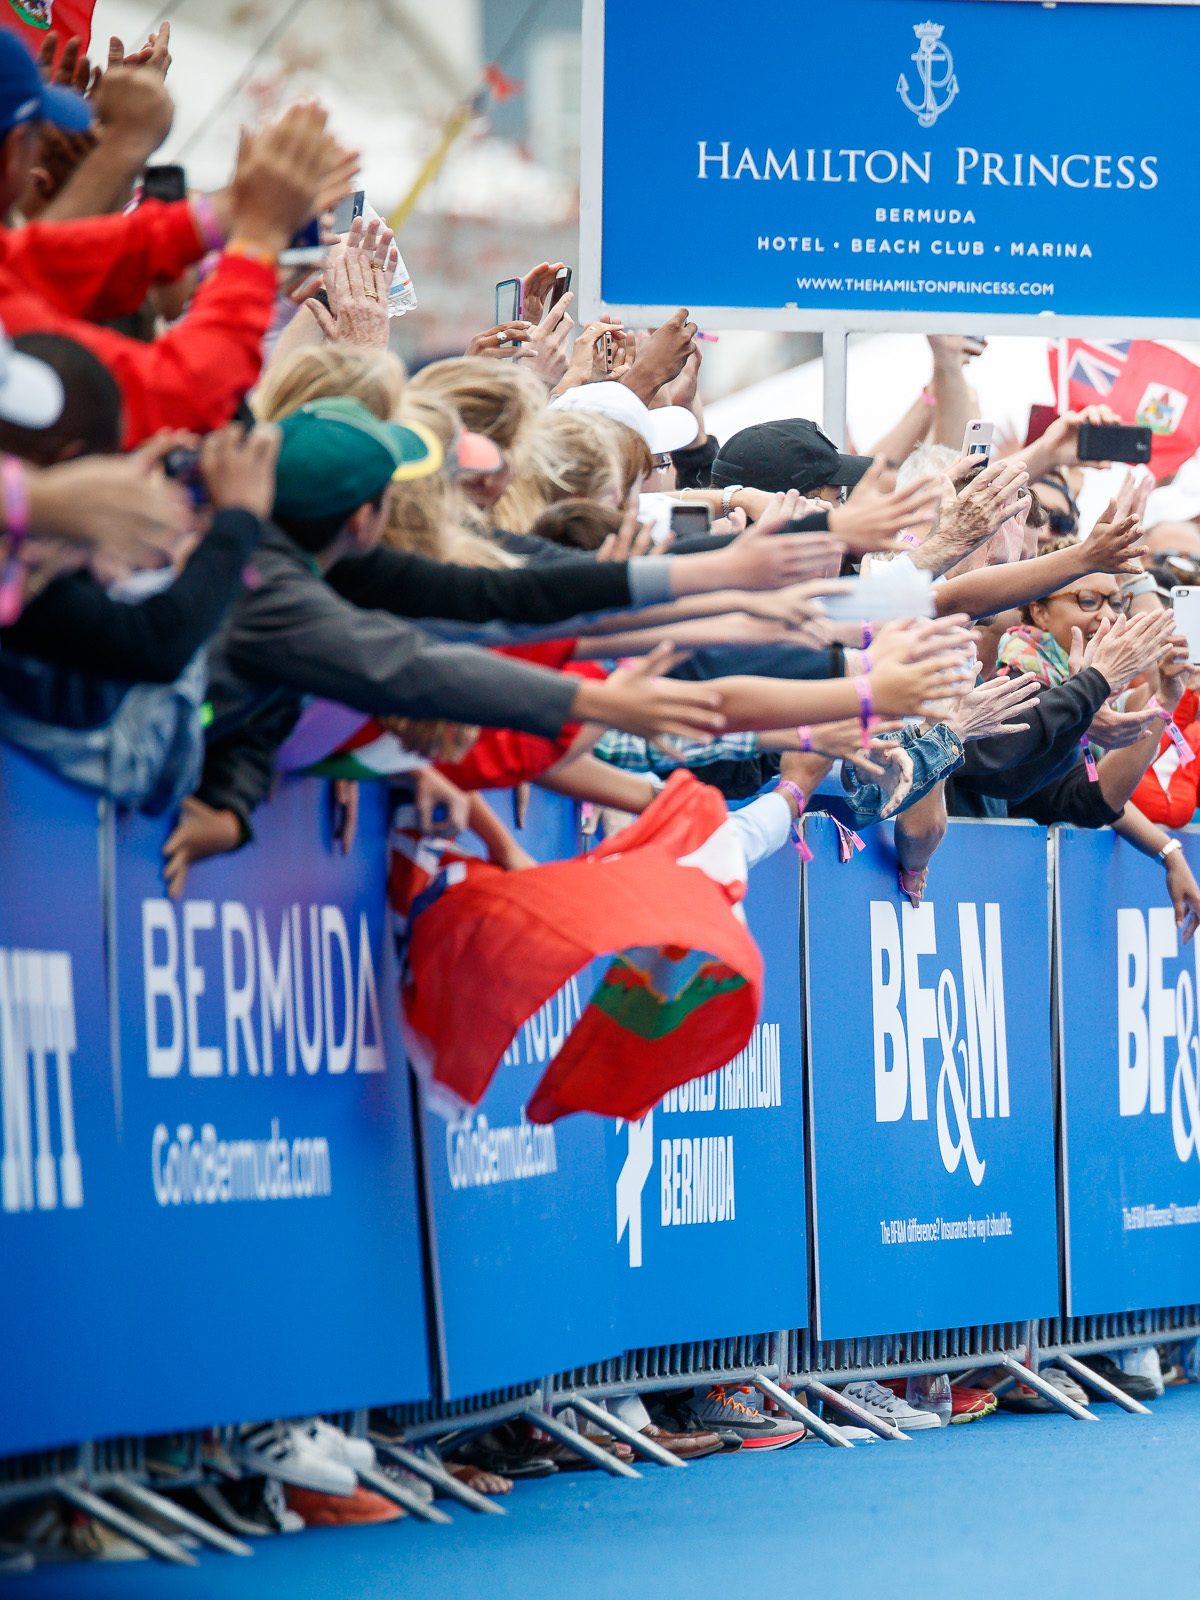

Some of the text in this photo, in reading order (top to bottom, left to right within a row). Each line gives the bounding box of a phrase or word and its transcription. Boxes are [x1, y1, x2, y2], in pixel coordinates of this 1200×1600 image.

[696, 140, 1159, 190] HAMILTON PRINCESS
[875, 207, 976, 224] BERMUDA
[757, 236, 1093, 258] HOTEL BEACH CLUB MARINA
[796, 277, 1055, 296] WWW.THEHAMILTONPRINCESS.COM
[142, 898, 387, 1078] BERMUDA
[869, 900, 1010, 1187] BF&M
[660, 1135, 736, 1227] BERMUDA
